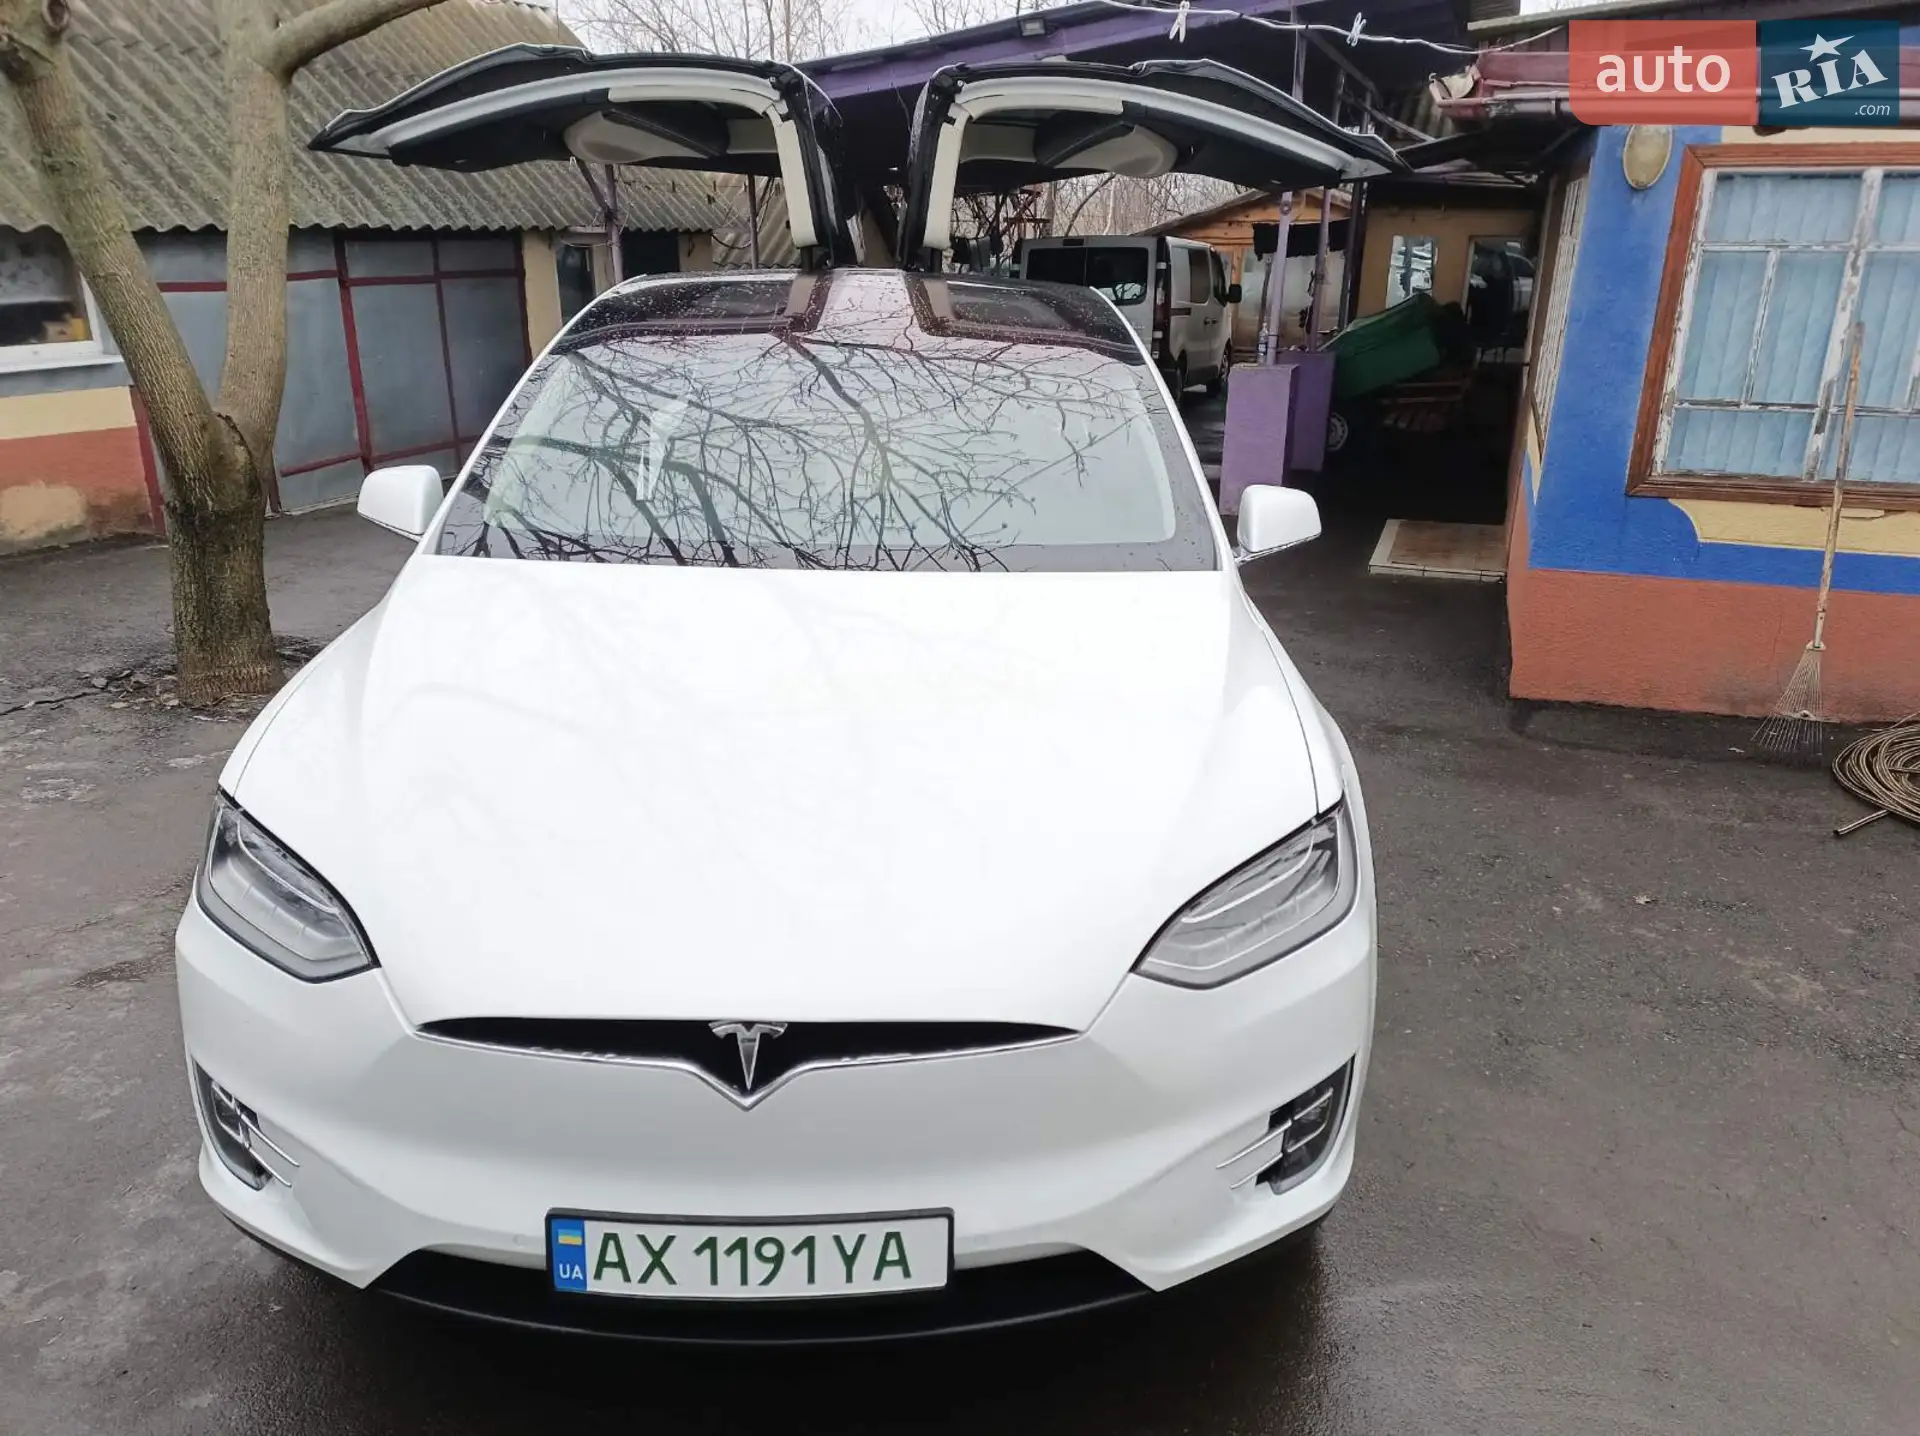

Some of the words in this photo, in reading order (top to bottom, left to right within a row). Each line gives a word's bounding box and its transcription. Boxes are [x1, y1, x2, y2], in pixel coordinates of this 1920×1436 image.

[559, 1263, 584, 1280] UA
[593, 1232, 678, 1285] AX
[692, 1235, 816, 1286] 1191
[832, 1231, 912, 1284] YA
